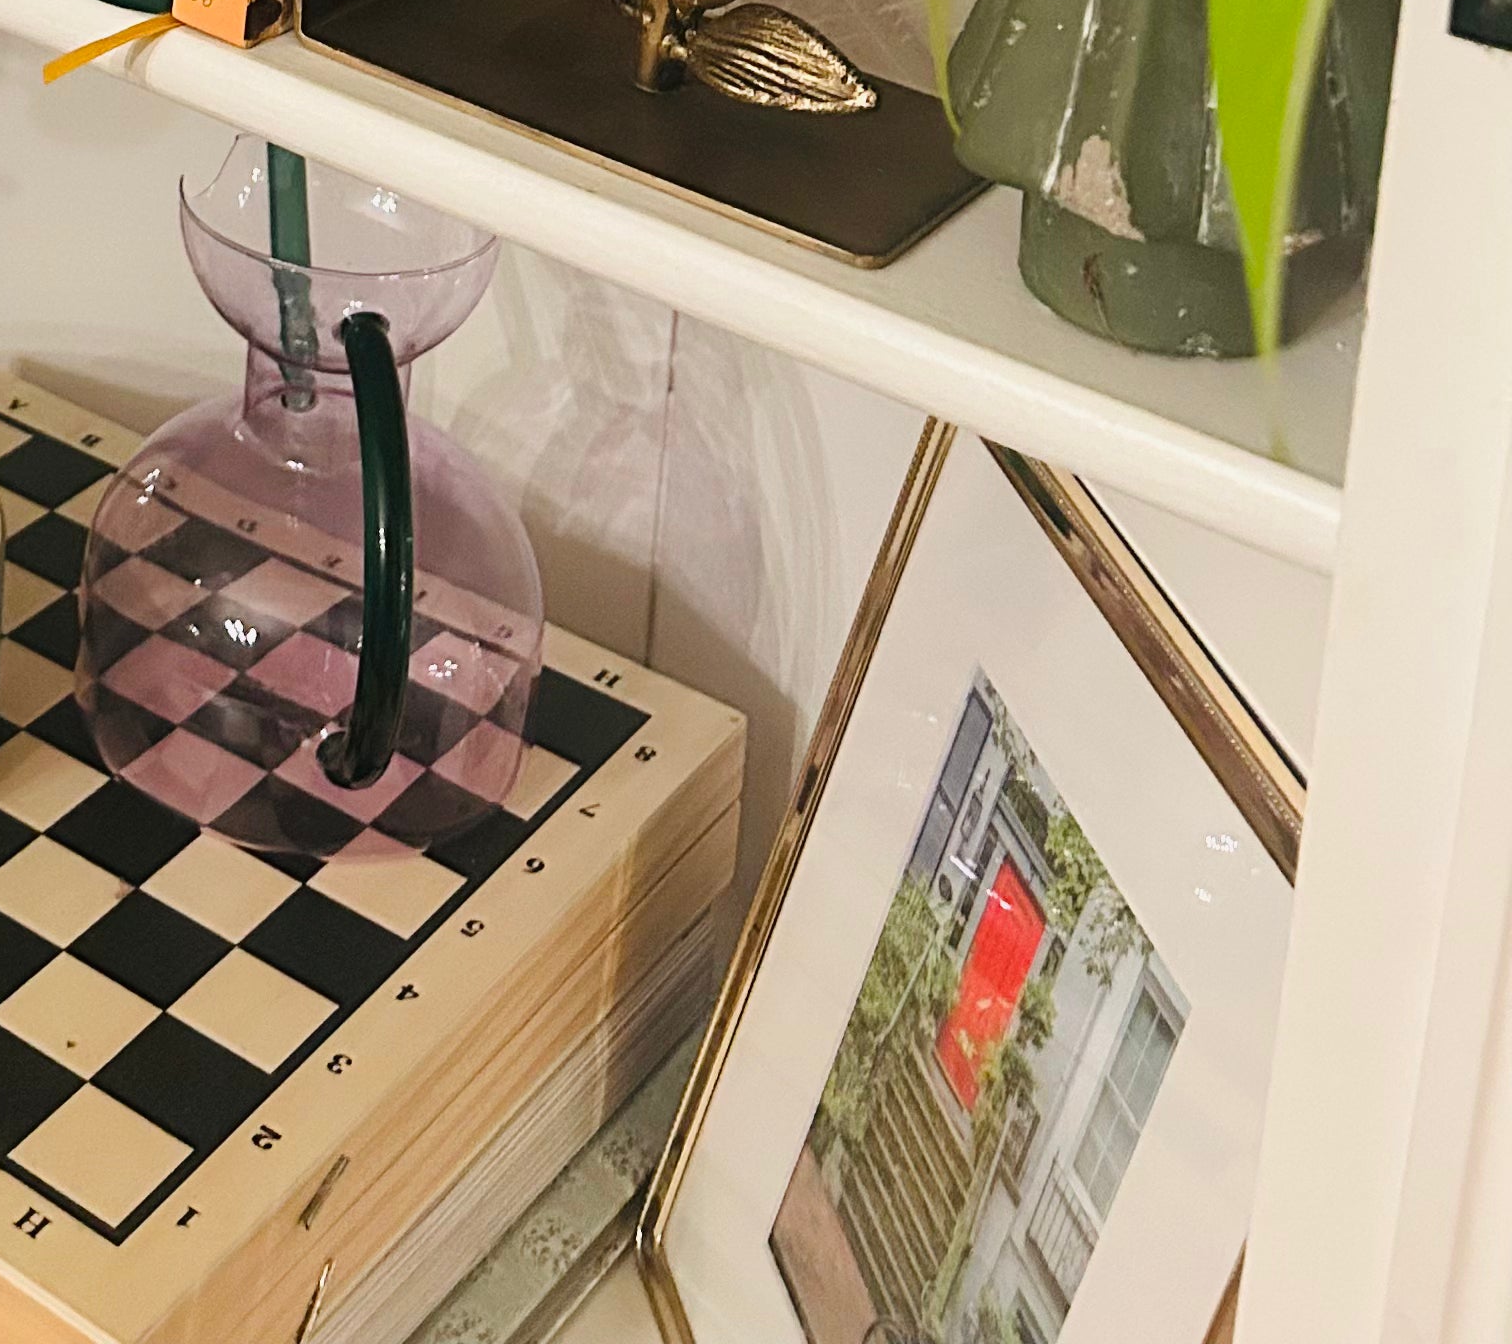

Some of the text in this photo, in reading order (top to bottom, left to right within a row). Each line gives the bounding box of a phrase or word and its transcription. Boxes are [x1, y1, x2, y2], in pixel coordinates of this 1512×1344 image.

[395, 984, 420, 1001] 4
[327, 1054, 353, 1075] 3
[251, 1124, 283, 1151] 2
[12, 1206, 53, 1241] H
